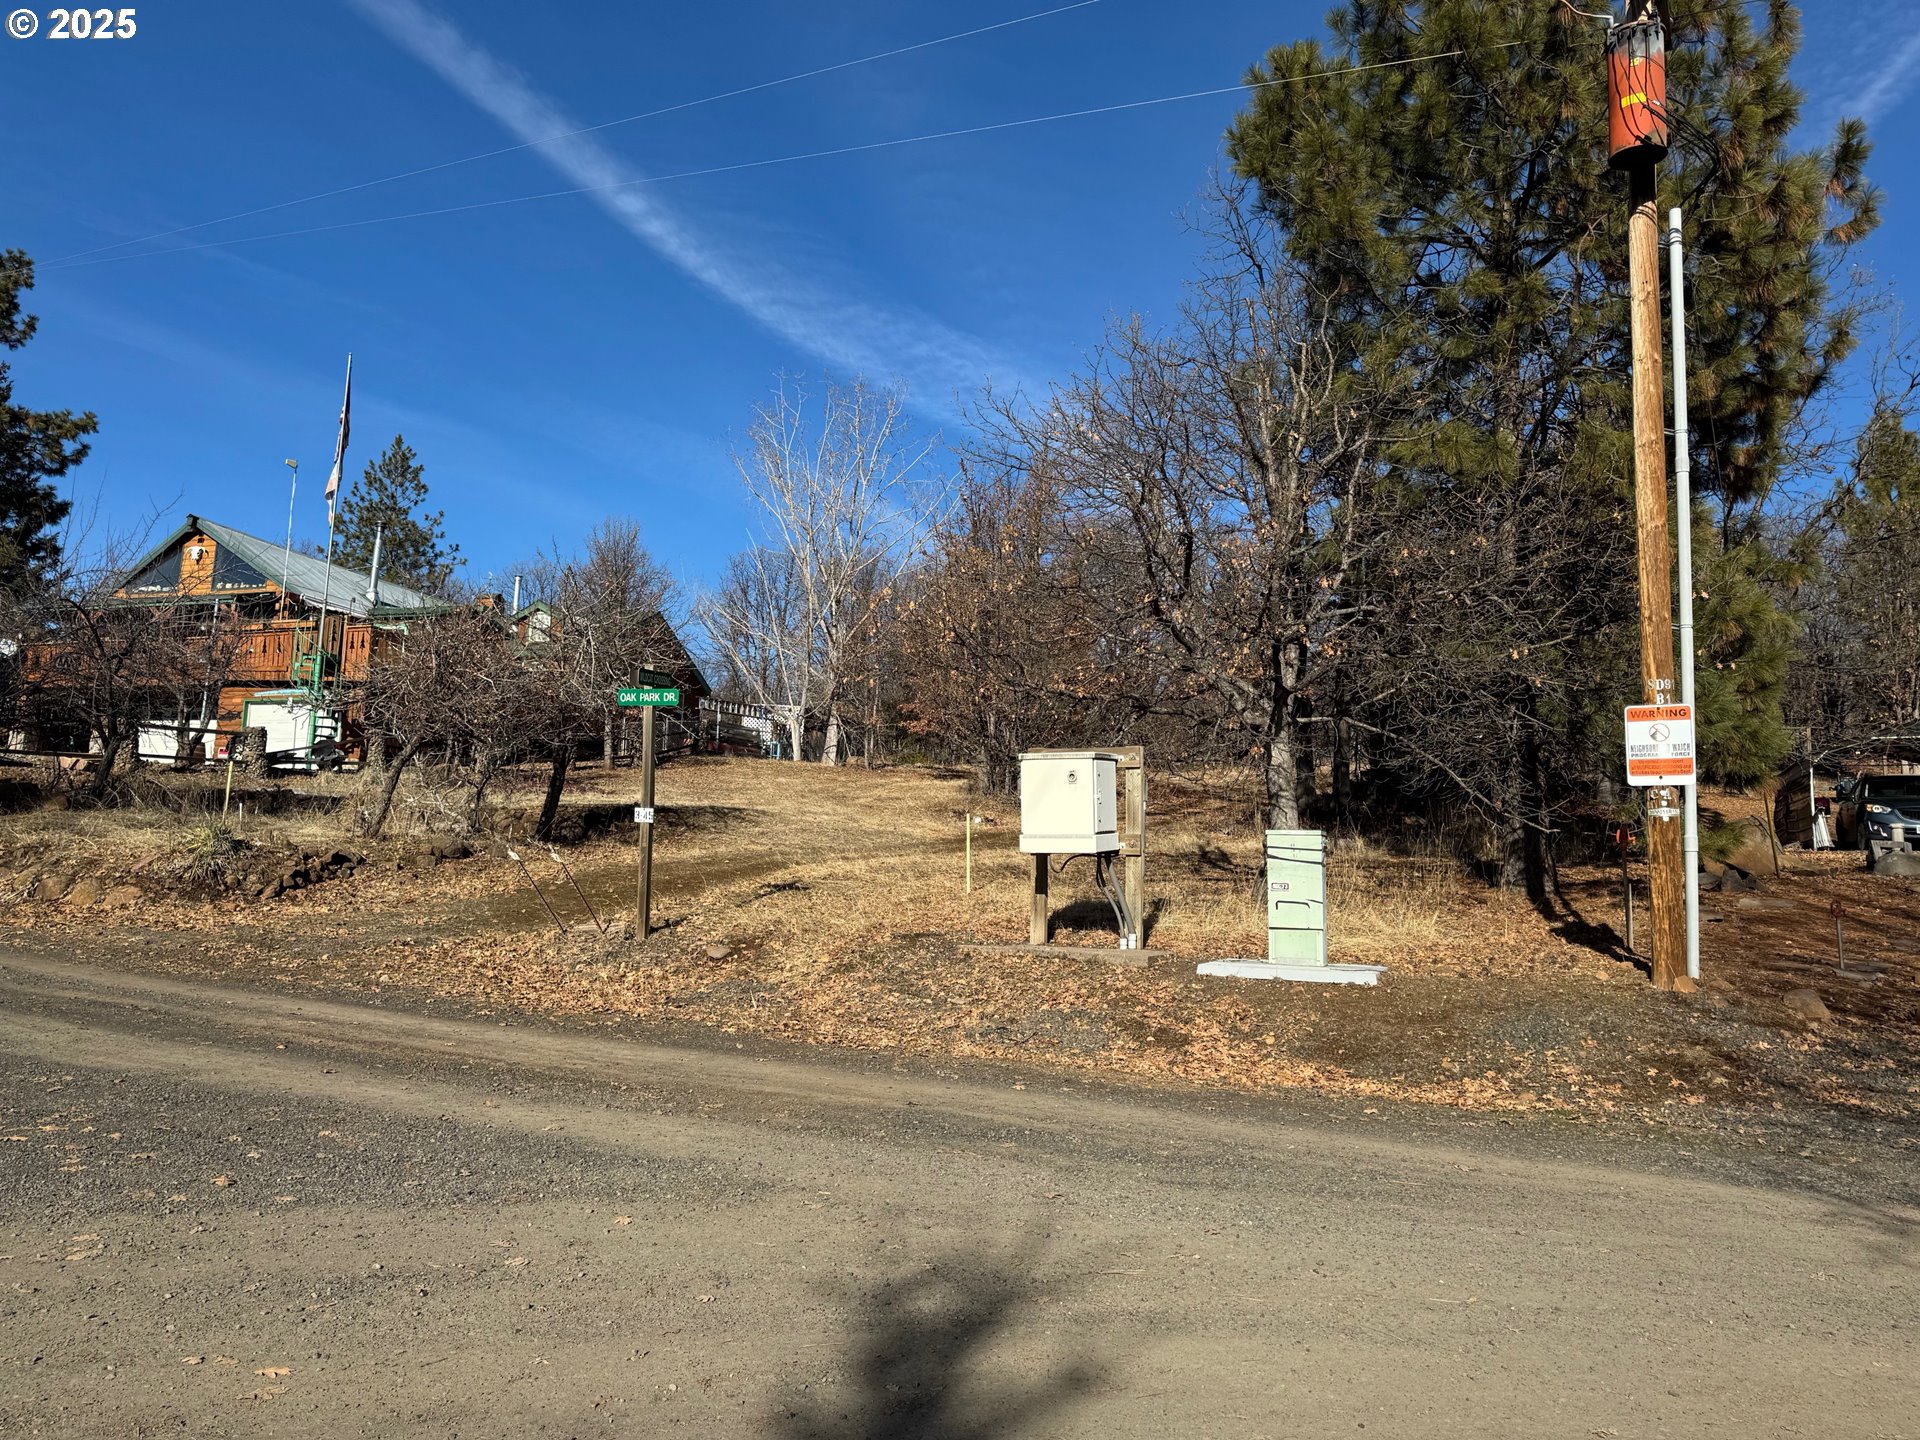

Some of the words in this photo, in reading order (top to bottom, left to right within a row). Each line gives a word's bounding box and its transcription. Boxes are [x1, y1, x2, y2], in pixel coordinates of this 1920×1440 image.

[620, 692, 636, 702] OAK
[640, 692, 660, 702] PARK
[663, 692, 677, 702] DR.
[1630, 708, 1687, 719] WARNING
[1672, 743, 1691, 752] WATCH
